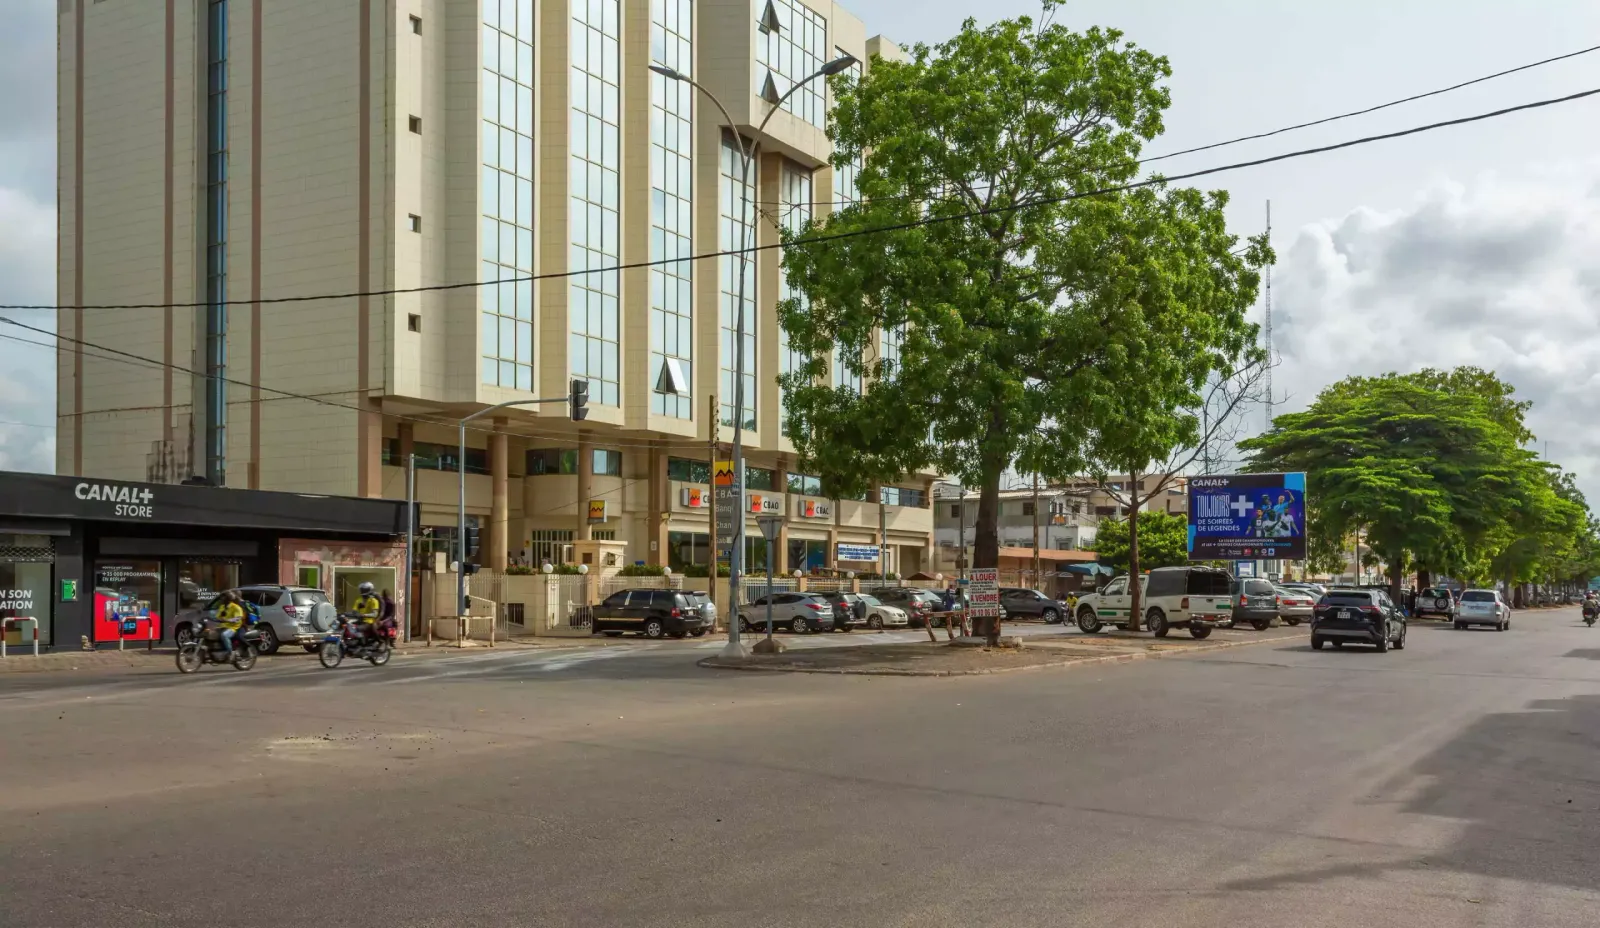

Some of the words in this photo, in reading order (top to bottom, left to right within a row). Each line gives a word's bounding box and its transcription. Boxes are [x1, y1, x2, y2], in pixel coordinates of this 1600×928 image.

[1191, 479, 1230, 487] CANAL+
[75, 483, 154, 504] CANAL+
[763, 500, 779, 510] CBAO
[1197, 495, 1230, 518] TOUJOURS
[115, 504, 153, 518] STORE
[976, 573, 997, 581] LOUER
[8, 590, 32, 599] SON
[976, 594, 997, 602] VENDRE
[0, 601, 33, 610] ATION
